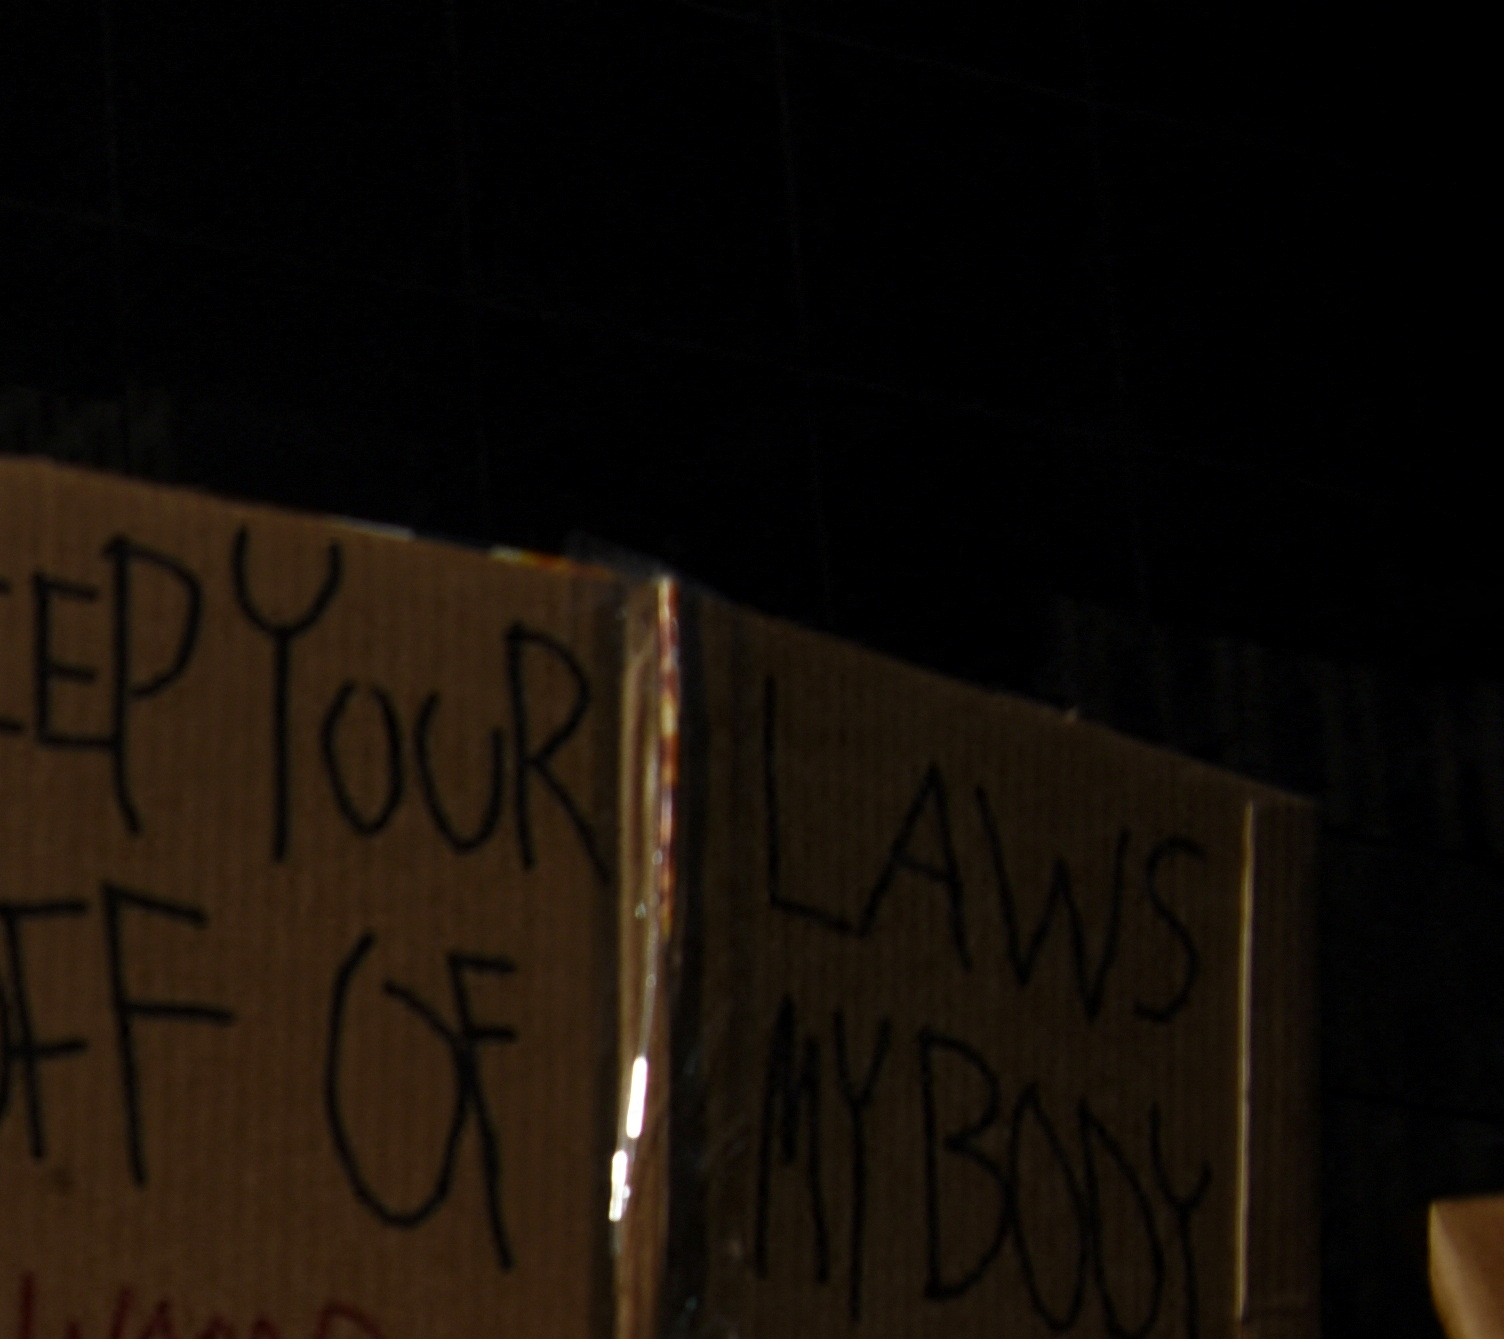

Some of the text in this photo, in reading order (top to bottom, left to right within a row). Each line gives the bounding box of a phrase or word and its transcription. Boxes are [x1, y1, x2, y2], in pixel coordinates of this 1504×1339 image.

[233, 527, 614, 885] YOUR
[764, 674, 1207, 1025] LAWS
[324, 932, 517, 1272] OF
[756, 993, 890, 1322] MY
